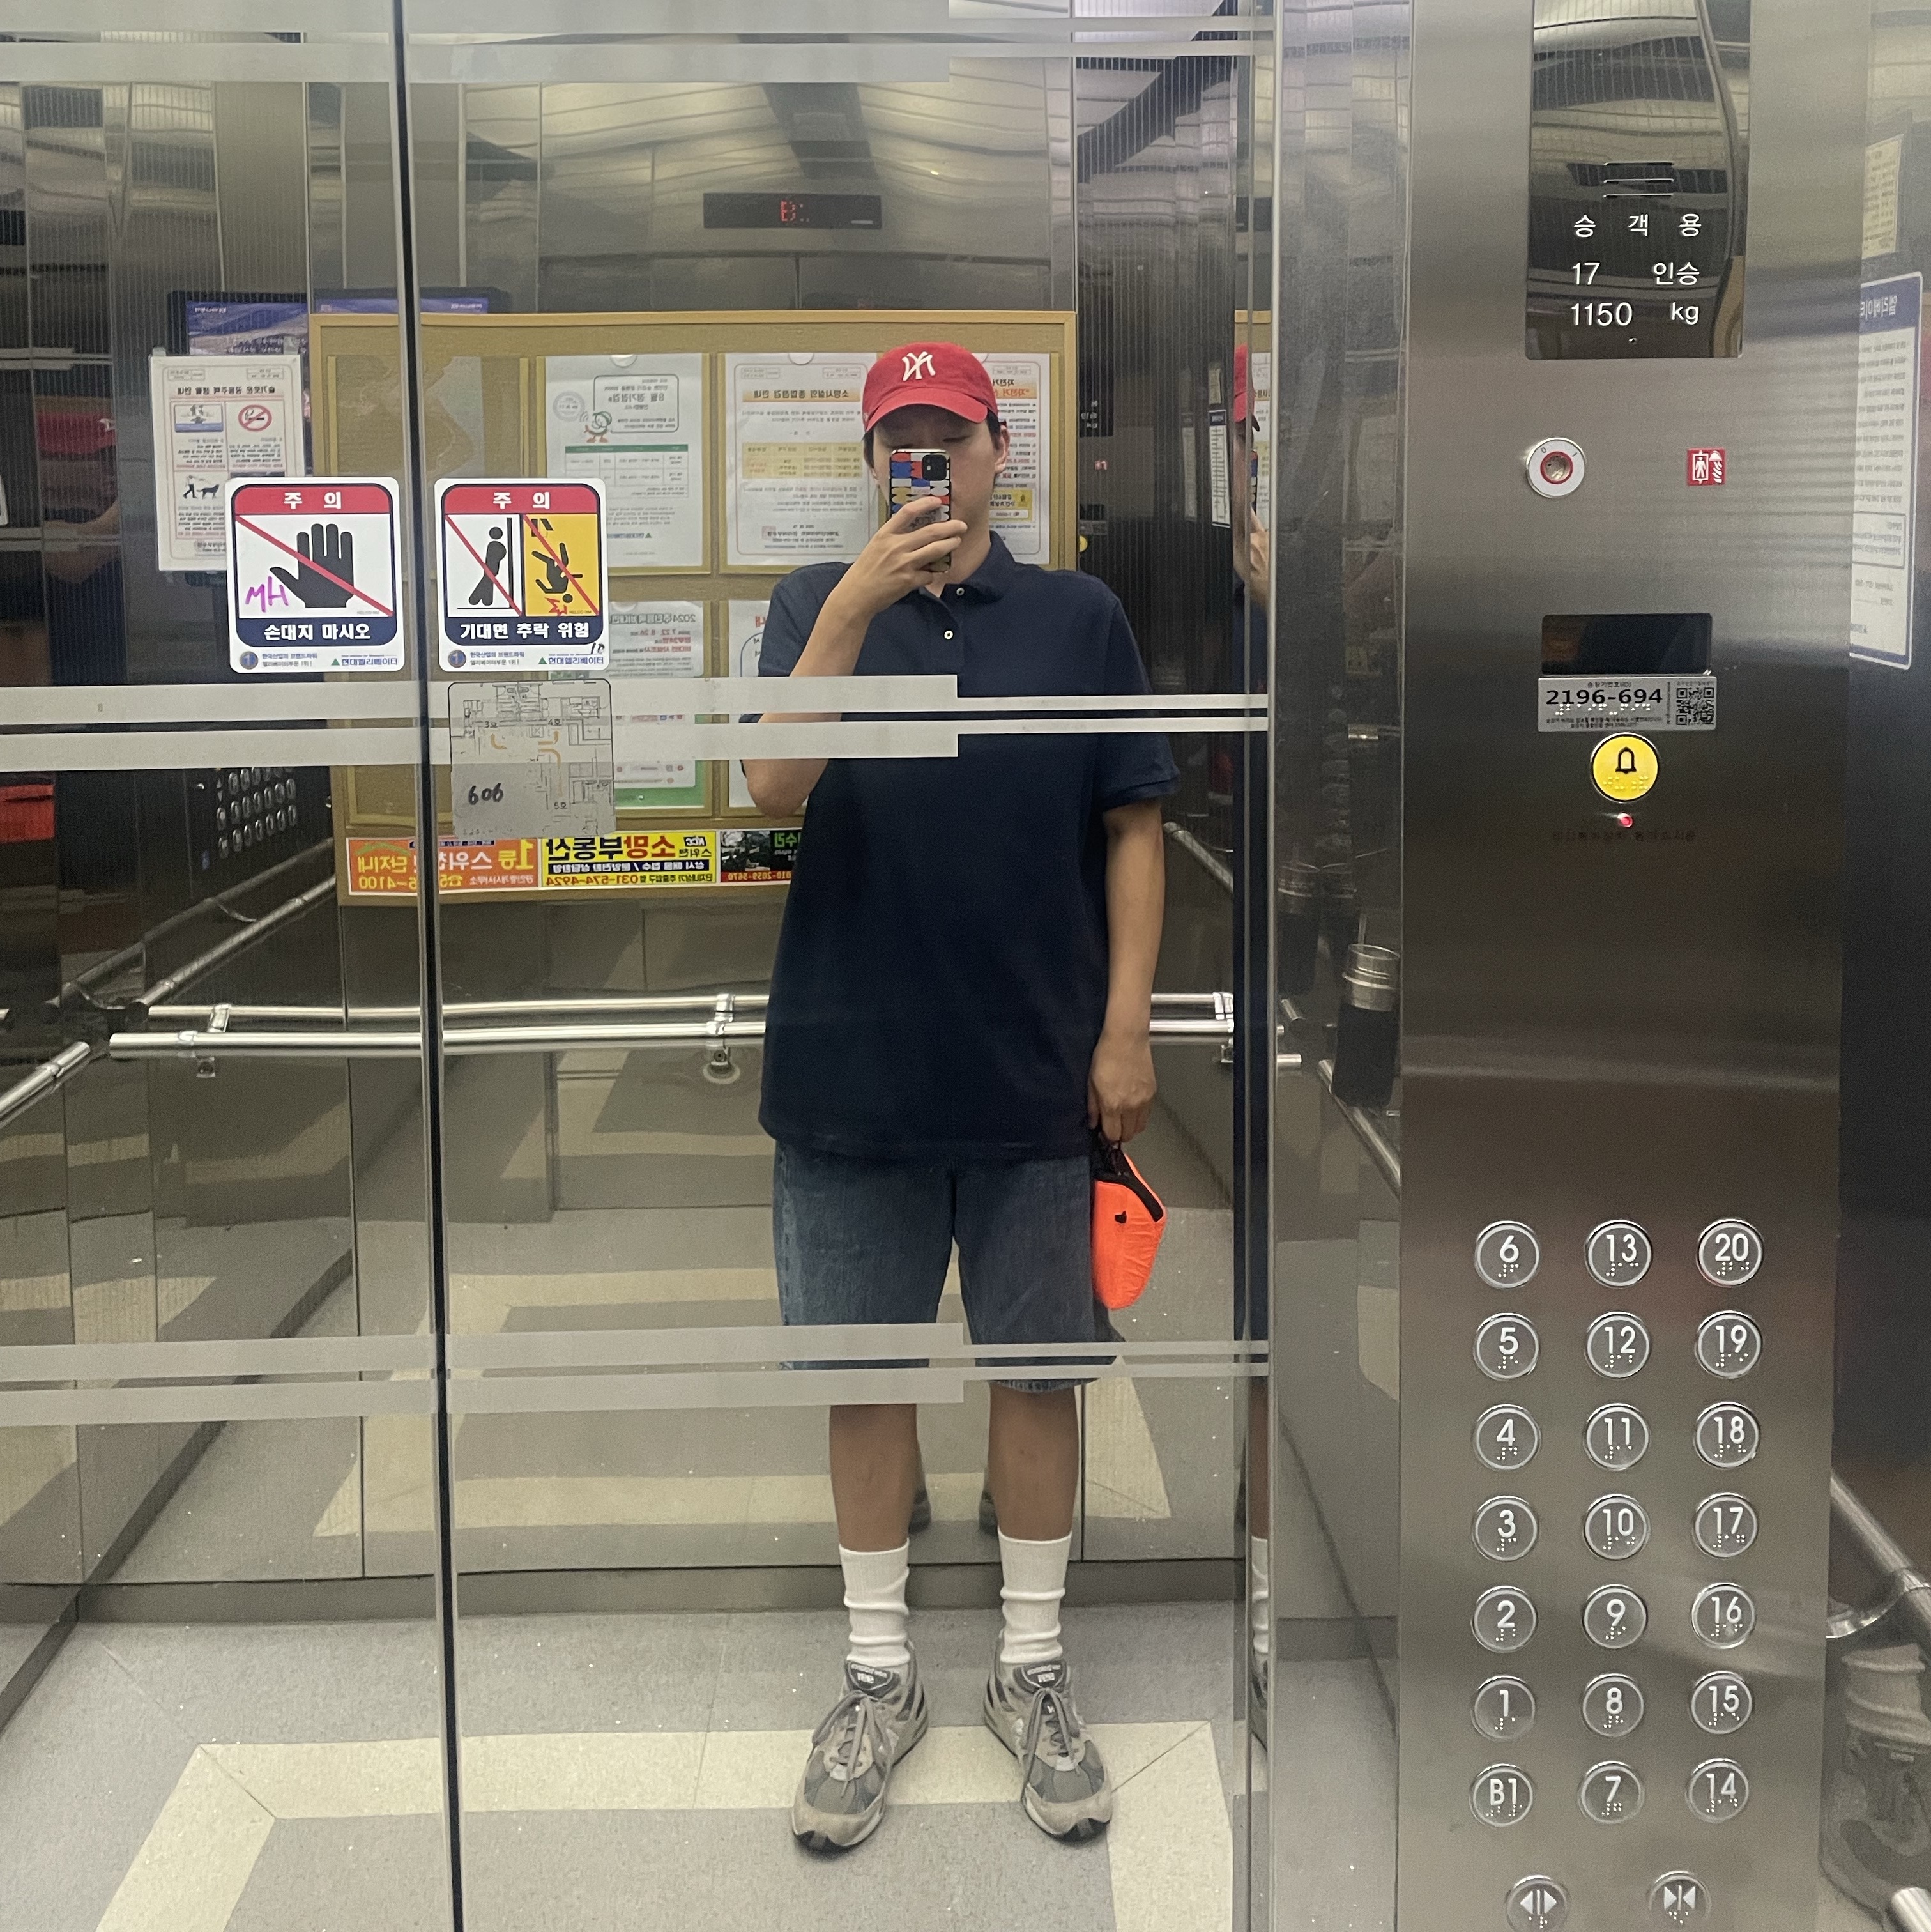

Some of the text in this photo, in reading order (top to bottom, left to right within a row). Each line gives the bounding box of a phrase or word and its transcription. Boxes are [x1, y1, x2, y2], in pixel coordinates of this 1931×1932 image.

[1573, 213, 1702, 238] 승 객 용
[1572, 261, 1700, 286] 17 인승
[1571, 302, 1699, 326] 1150 kg
[283, 491, 342, 509] 주 의
[492, 491, 550, 509] 주 의
[245, 576, 289, 612] MH
[264, 623, 371, 640] 손대지 마시오
[460, 622, 589, 640] 기대면 추락 위험
[548, 656, 604, 665] 현대엘리베이터
[1546, 689, 1663, 705] 2196-694
[468, 783, 503, 806] 606
[1499, 1235, 1519, 1263] 6
[1605, 1234, 1637, 1262] 13
[1714, 1233, 1748, 1261] 20
[1499, 1327, 1518, 1355] 5
[1605, 1326, 1635, 1354] 12
[1716, 1324, 1747, 1353] 19
[1497, 1418, 1516, 1446] 4
[1604, 1418, 1630, 1445] 11
[1714, 1416, 1745, 1445] 18
[1497, 1509, 1516, 1538] 3
[1603, 1508, 1634, 1536] 10
[1713, 1507, 1743, 1535] 17
[1497, 1600, 1515, 1628] 2
[1607, 1598, 1626, 1627] 9
[1711, 1597, 1742, 1623] 16
[1499, 1690, 1509, 1717] 1
[1606, 1687, 1623, 1715] 8
[1709, 1685, 1739, 1713] 15
[1490, 1778, 1517, 1805] B1
[1605, 1775, 1621, 1802] 7
[1706, 1773, 1736, 1800] 14
